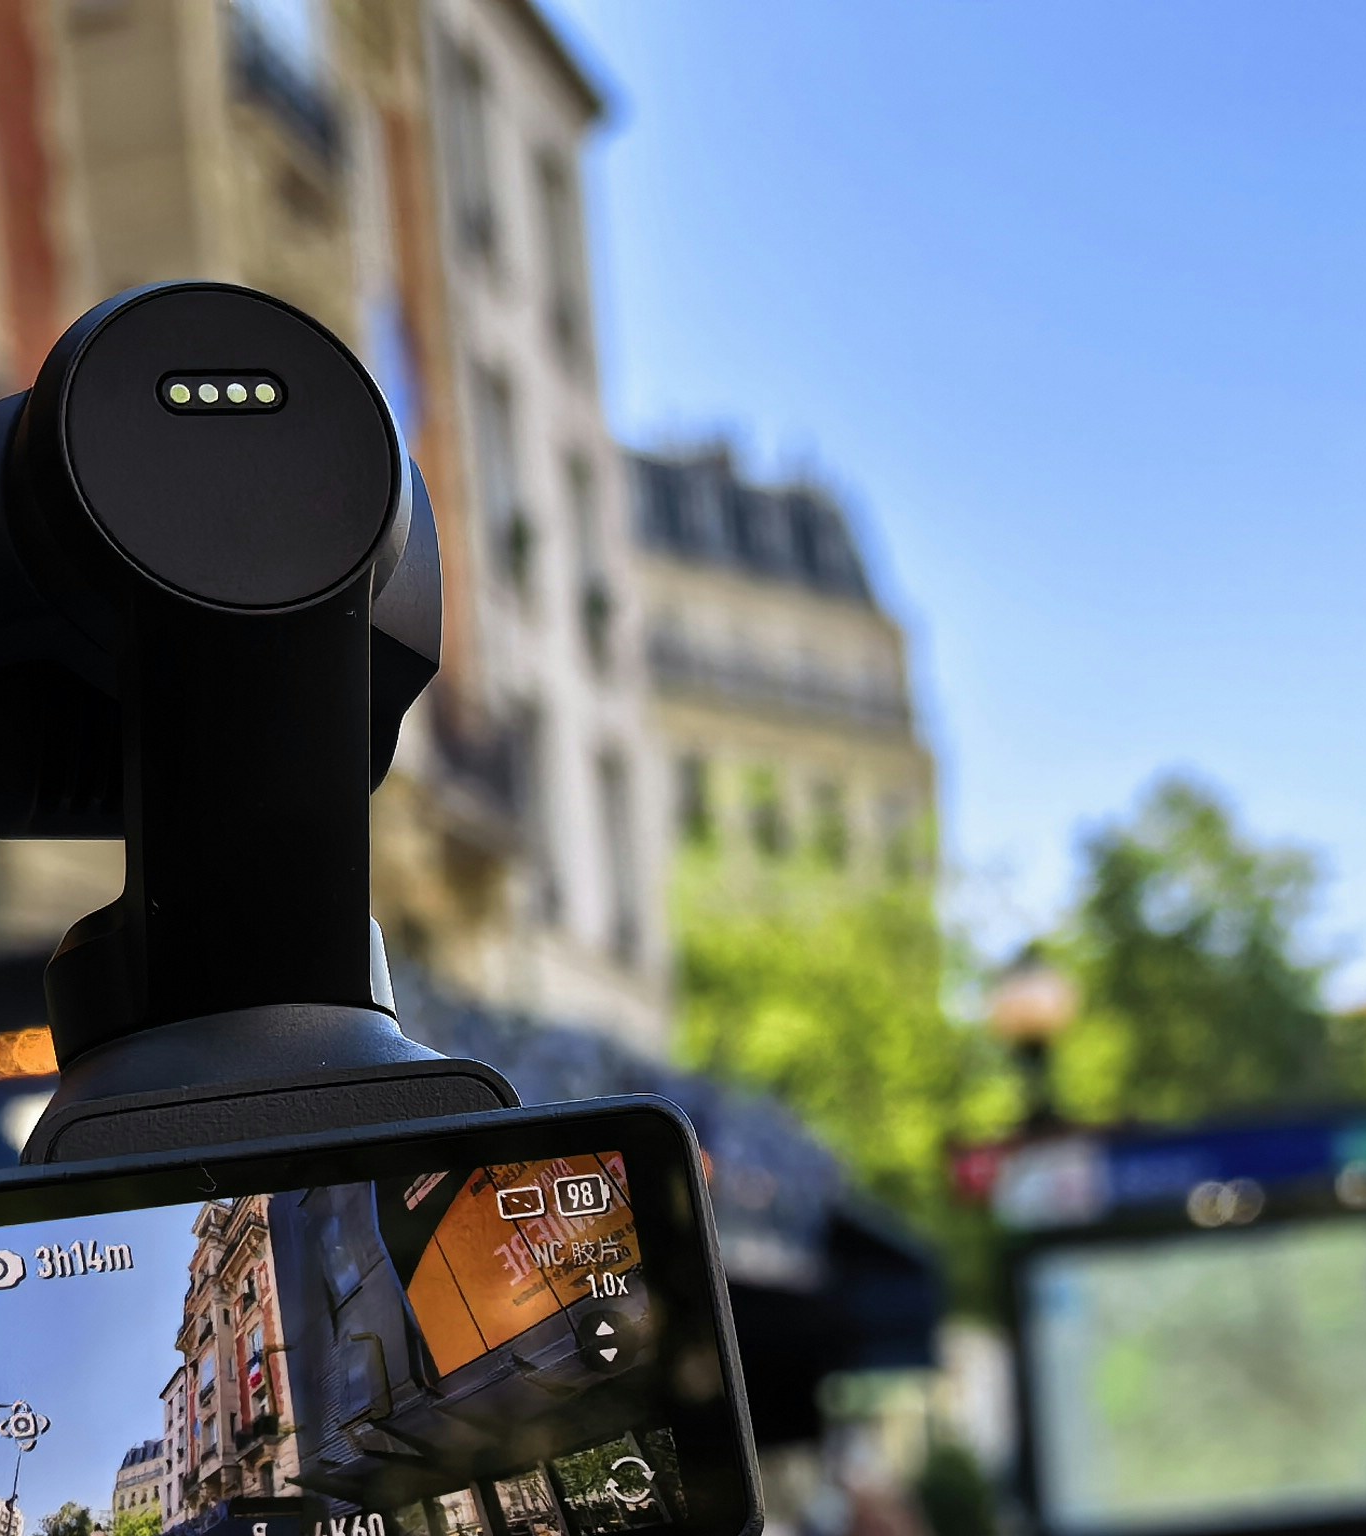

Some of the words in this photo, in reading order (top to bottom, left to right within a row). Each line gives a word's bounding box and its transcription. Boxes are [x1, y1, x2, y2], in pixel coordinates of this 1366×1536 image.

[567, 1181, 595, 1209] 98
[35, 1240, 134, 1279] 3h14m
[585, 1271, 629, 1299] 1.0x
